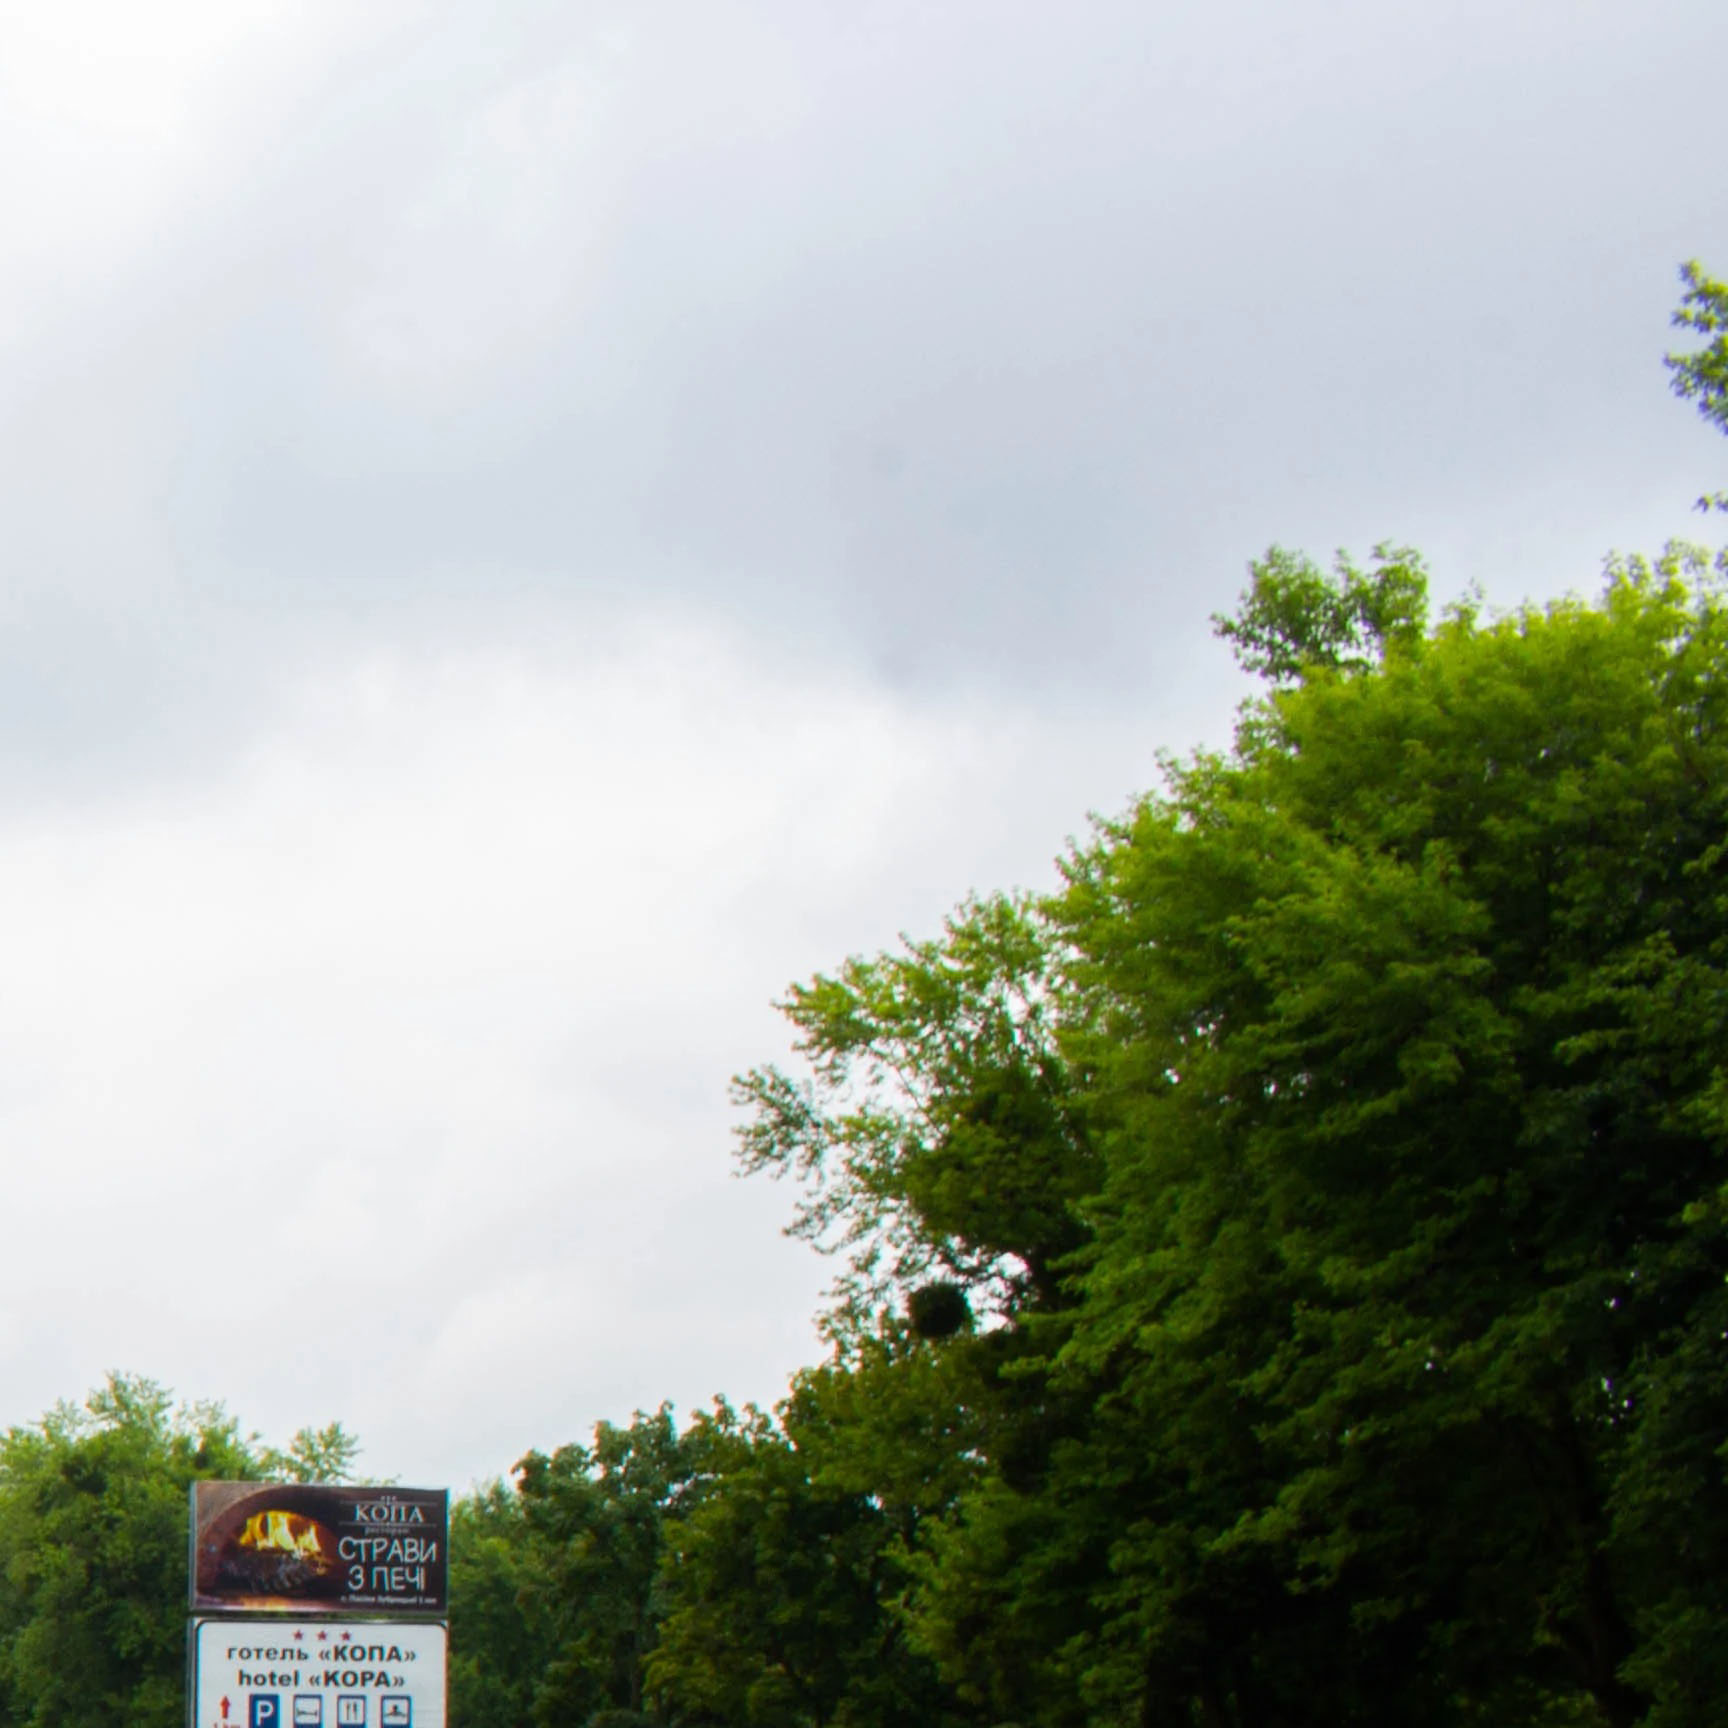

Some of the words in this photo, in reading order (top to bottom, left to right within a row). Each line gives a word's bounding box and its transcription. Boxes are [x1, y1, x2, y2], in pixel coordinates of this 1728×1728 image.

[355, 1504, 425, 1522] КОПА
[338, 1536, 437, 1563] СТРАВИ
[372, 1565, 425, 1591] ПЕЧІ
[226, 1646, 309, 1661] готель
[318, 1644, 417, 1662] «КОПА»
[237, 1669, 301, 1687] hotel
[255, 1700, 274, 1727] P
